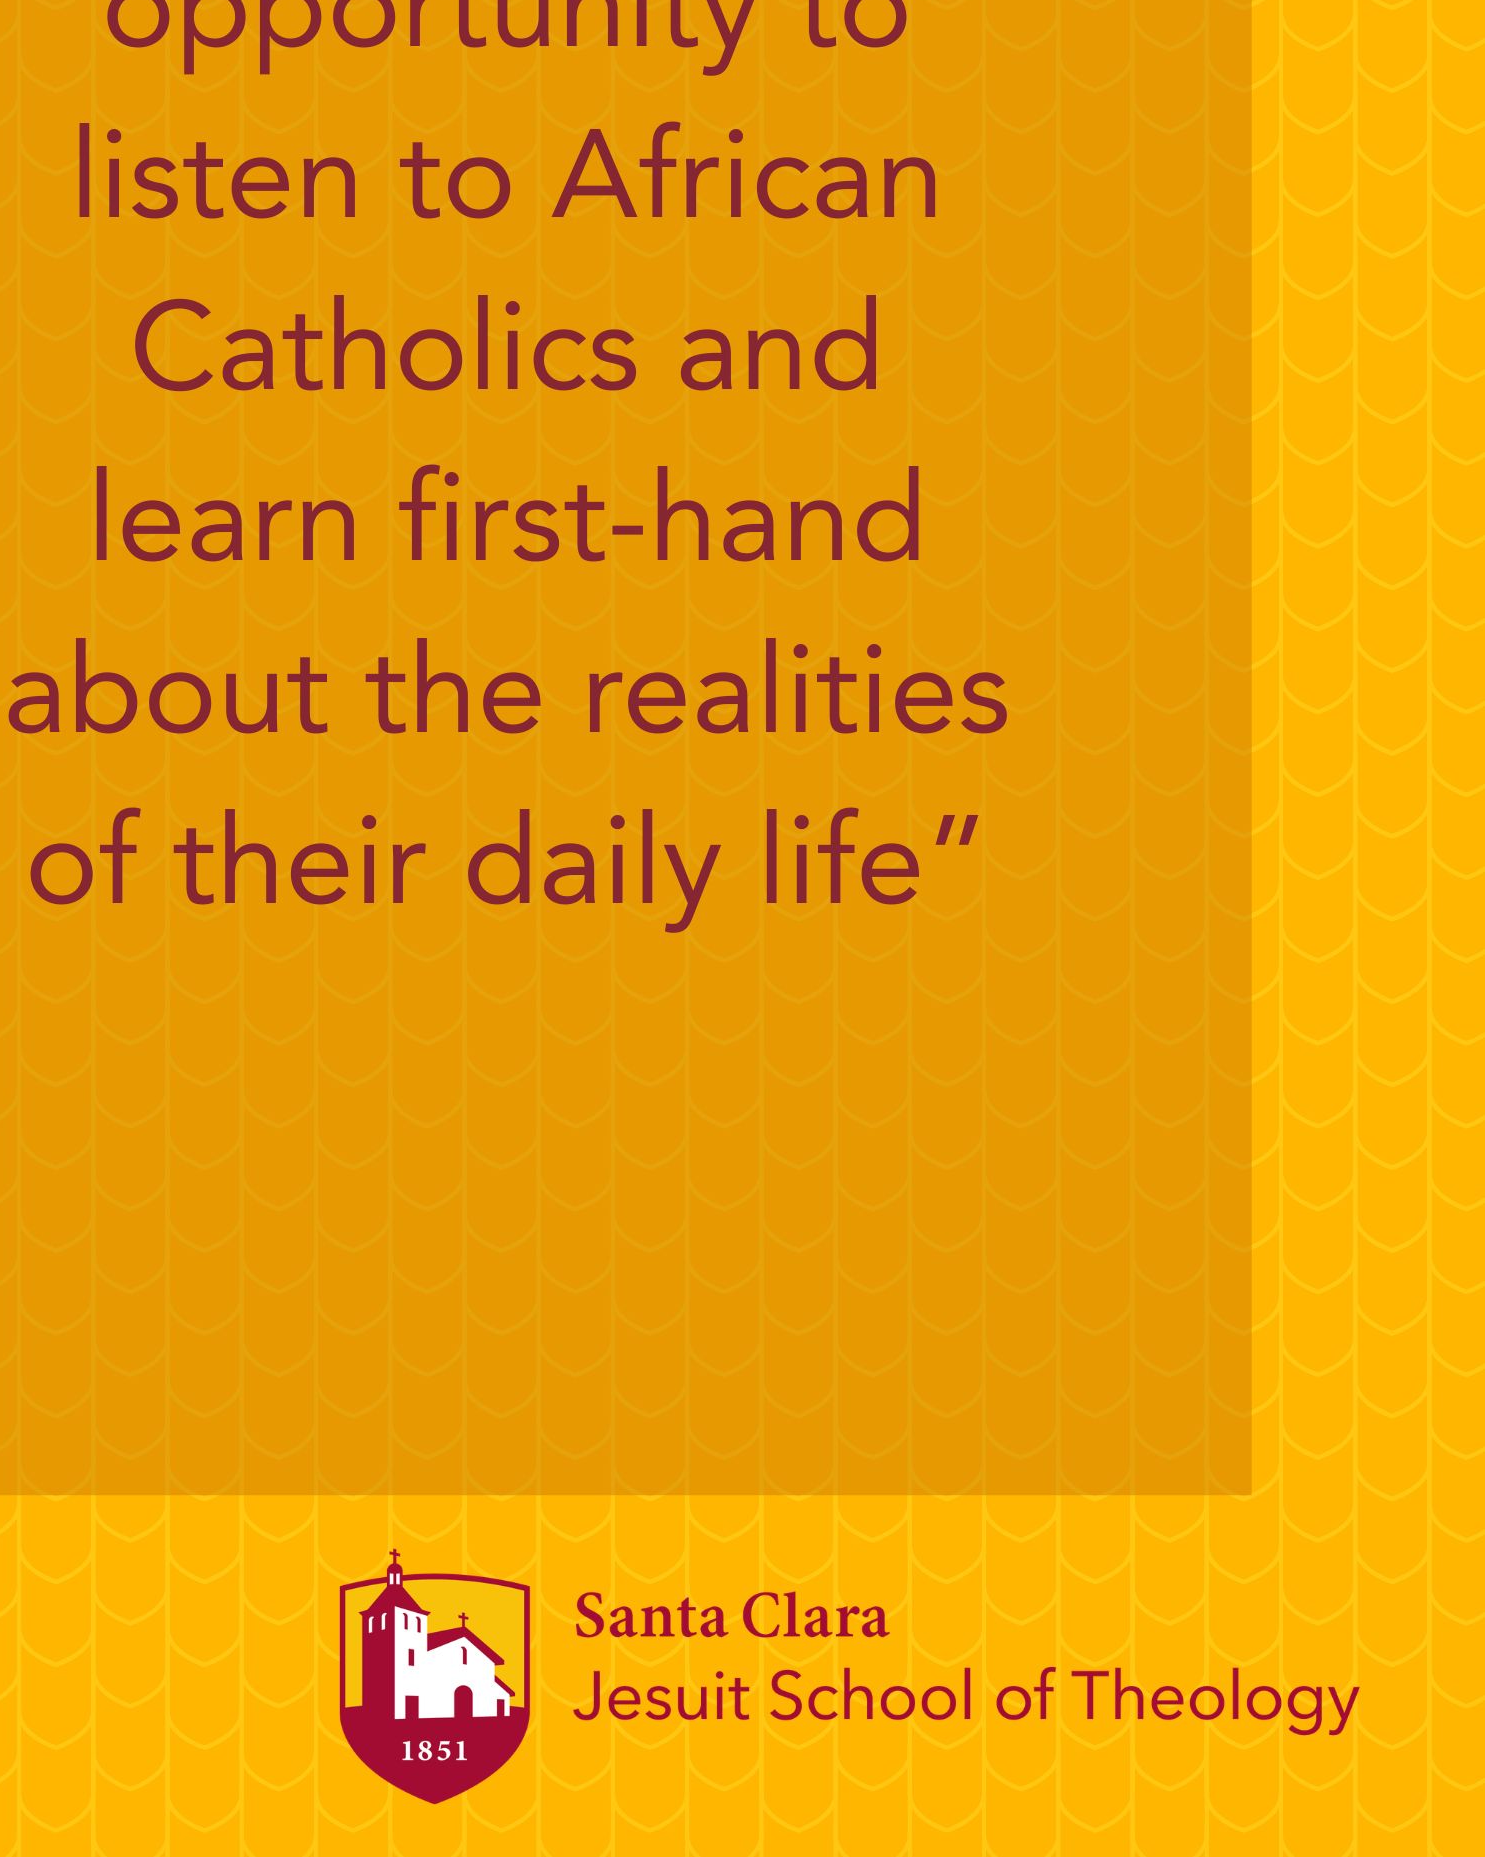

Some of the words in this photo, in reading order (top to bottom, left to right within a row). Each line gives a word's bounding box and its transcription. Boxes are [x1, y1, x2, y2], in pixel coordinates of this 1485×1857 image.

[79, 123, 355, 219] listen
[400, 142, 510, 218] to
[552, 122, 935, 218] African
[135, 295, 636, 391] Catholics
[681, 295, 876, 391] and
[97, 466, 354, 562] learn
[399, 465, 919, 562] first-hand
[9, 638, 327, 734] about
[366, 638, 541, 734] the
[589, 638, 1007, 734] realities
[31, 808, 141, 904] of
[174, 809, 426, 905] their
[468, 809, 721, 933] daily
[767, 808, 978, 905] life”
[576, 1593, 728, 1637] Santa
[743, 1592, 889, 1637] Clara
[574, 1671, 749, 1720] Jesuit
[771, 1668, 970, 1720] School
[997, 1667, 1056, 1720] of
[1072, 1668, 1359, 1735] Theology
[402, 1741, 467, 1761] 1851
